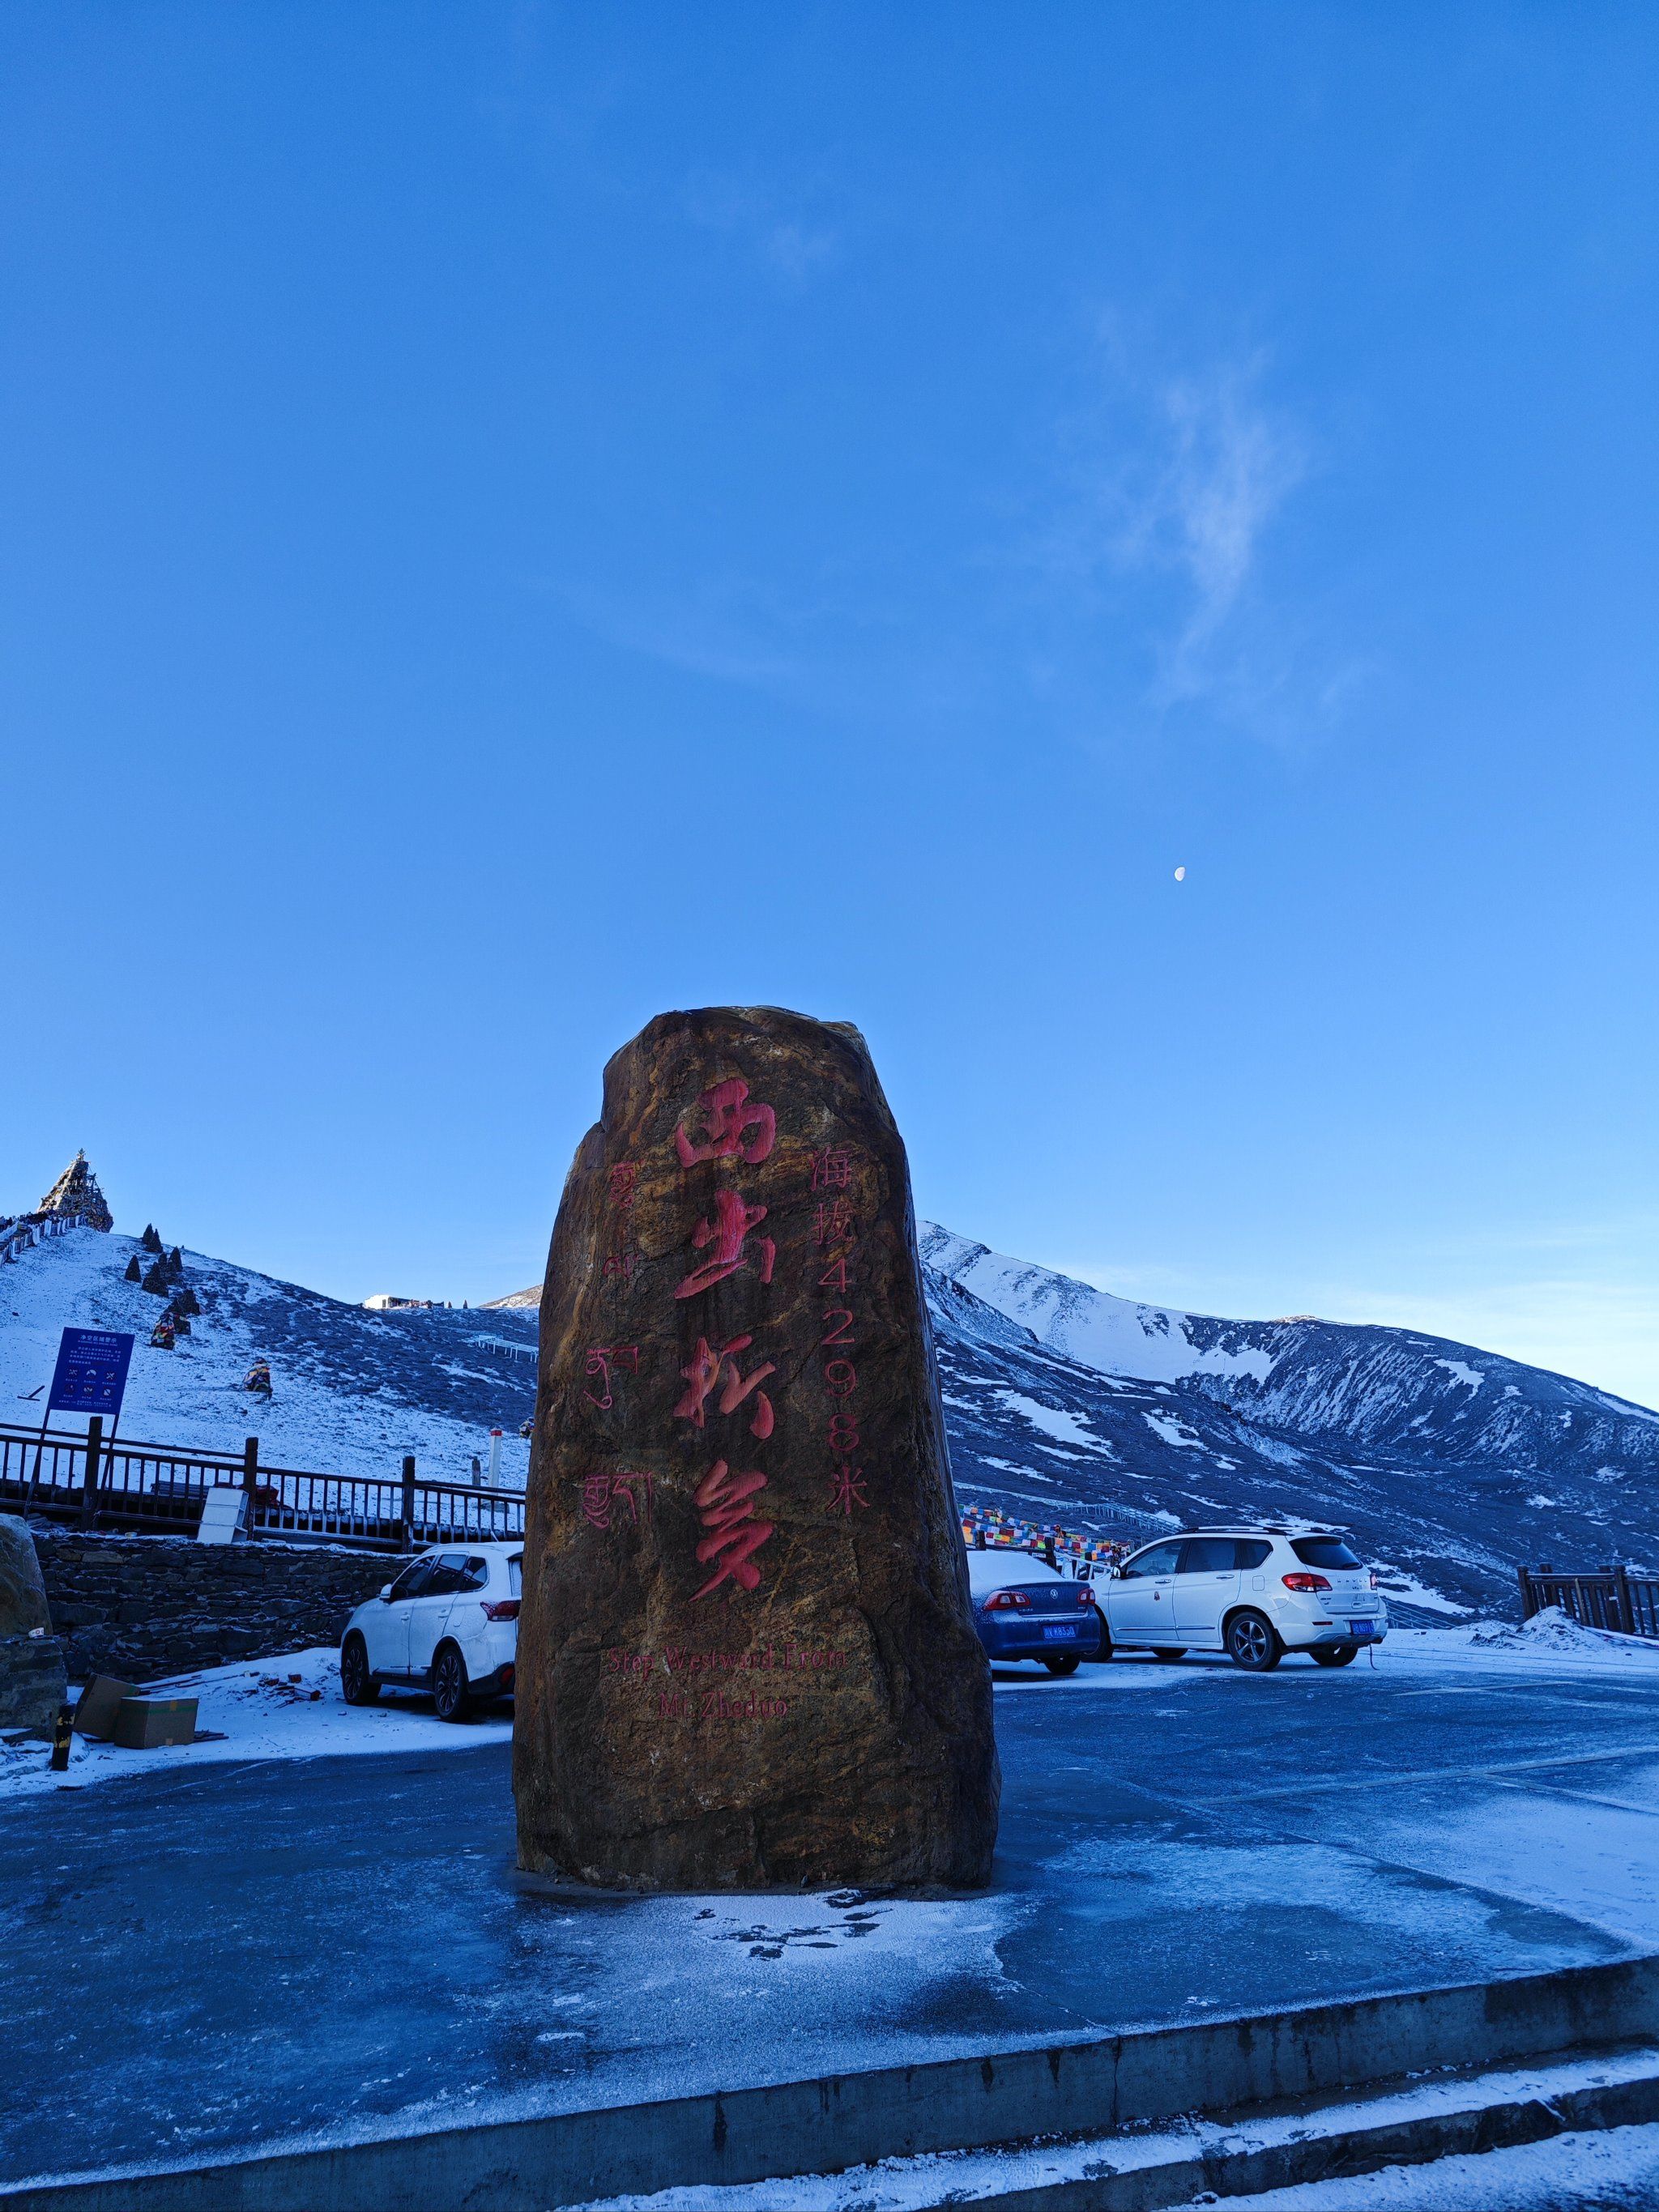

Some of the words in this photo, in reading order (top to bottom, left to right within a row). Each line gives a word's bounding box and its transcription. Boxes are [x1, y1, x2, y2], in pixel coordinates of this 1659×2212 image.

[674, 1078, 776, 1601] 西出折多
[810, 1147, 870, 1515] 海拔4298米
[608, 1646, 655, 1681] Step
[663, 1643, 774, 1672] Westward
[783, 1643, 847, 1670] From
[701, 1690, 788, 1719] Zheduo
